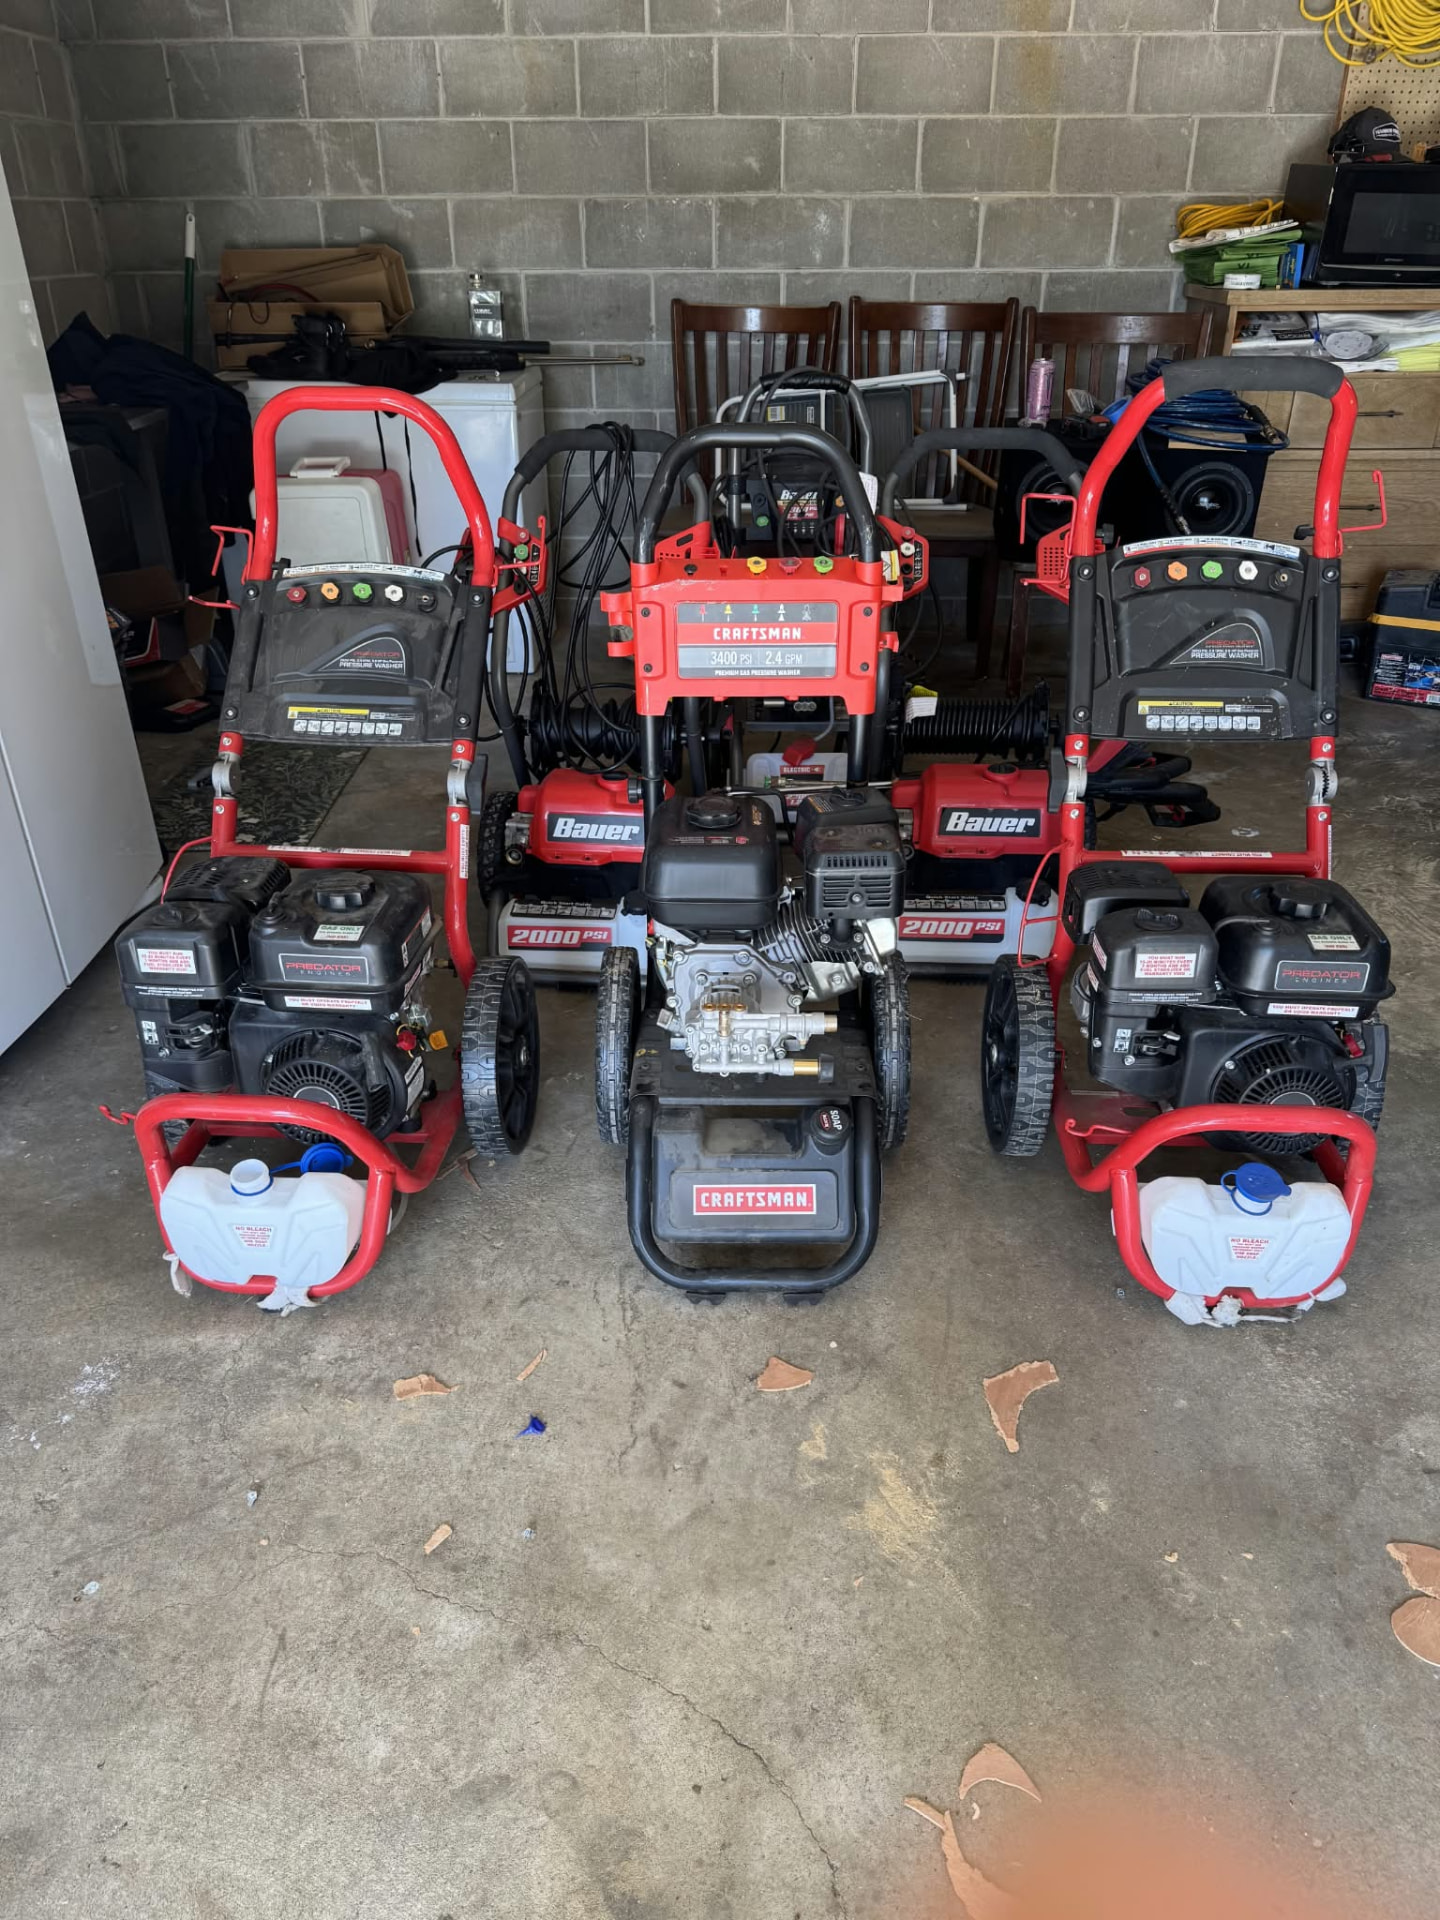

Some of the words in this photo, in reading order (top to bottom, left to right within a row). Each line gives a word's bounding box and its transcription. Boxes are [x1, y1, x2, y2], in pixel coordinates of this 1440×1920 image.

[714, 628, 801, 640] CRAFTSMAN
[710, 651, 737, 665] 3400
[740, 652, 752, 664] PSI
[766, 652, 782, 665] 2.4
[785, 652, 802, 665] GPM
[553, 818, 640, 840] Bauer
[946, 812, 1035, 832] Bauer
[903, 920, 974, 935] 2000
[975, 922, 1002, 930] PSI
[512, 929, 581, 944] 2000
[582, 931, 608, 939] PSI
[285, 962, 361, 971] PREDATOR
[1282, 970, 1360, 978] PREDATOR
[830, 1110, 842, 1130] SOAP
[701, 1192, 806, 1207] CRAFTSMAN
